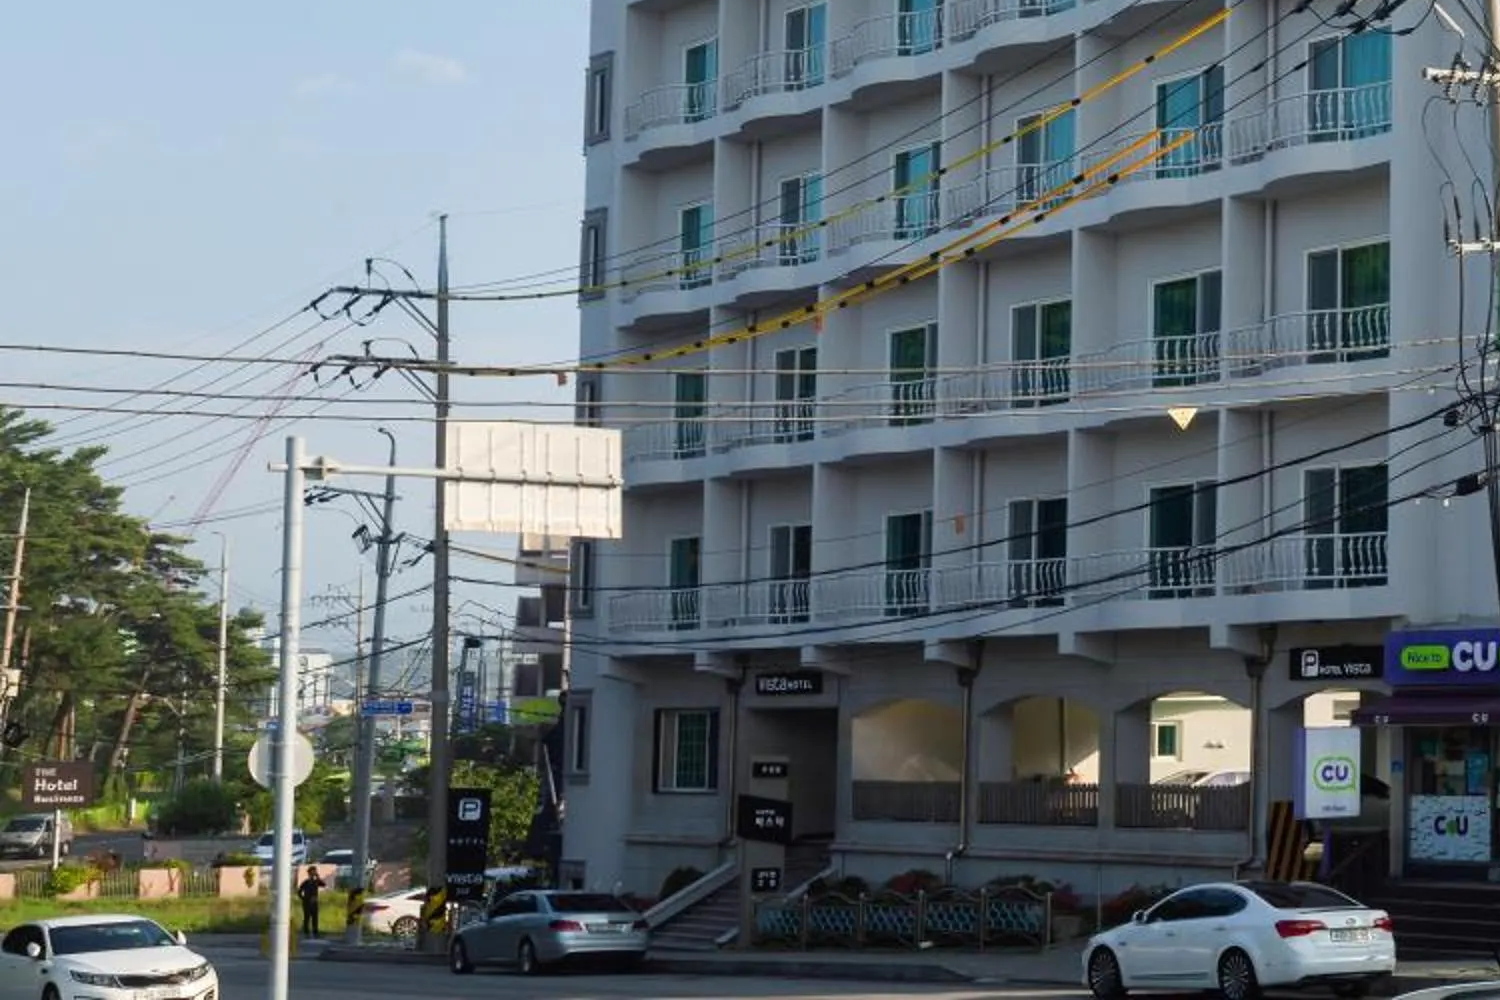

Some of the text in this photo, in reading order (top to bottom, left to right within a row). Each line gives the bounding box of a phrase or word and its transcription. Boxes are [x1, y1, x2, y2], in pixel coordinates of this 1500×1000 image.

[1451, 640, 1497, 672] CU
[1471, 712, 1489, 723] CU
[1320, 764, 1349, 783] CU
[34, 778, 78, 792] Hotel
[1433, 814, 1469, 836] CU
